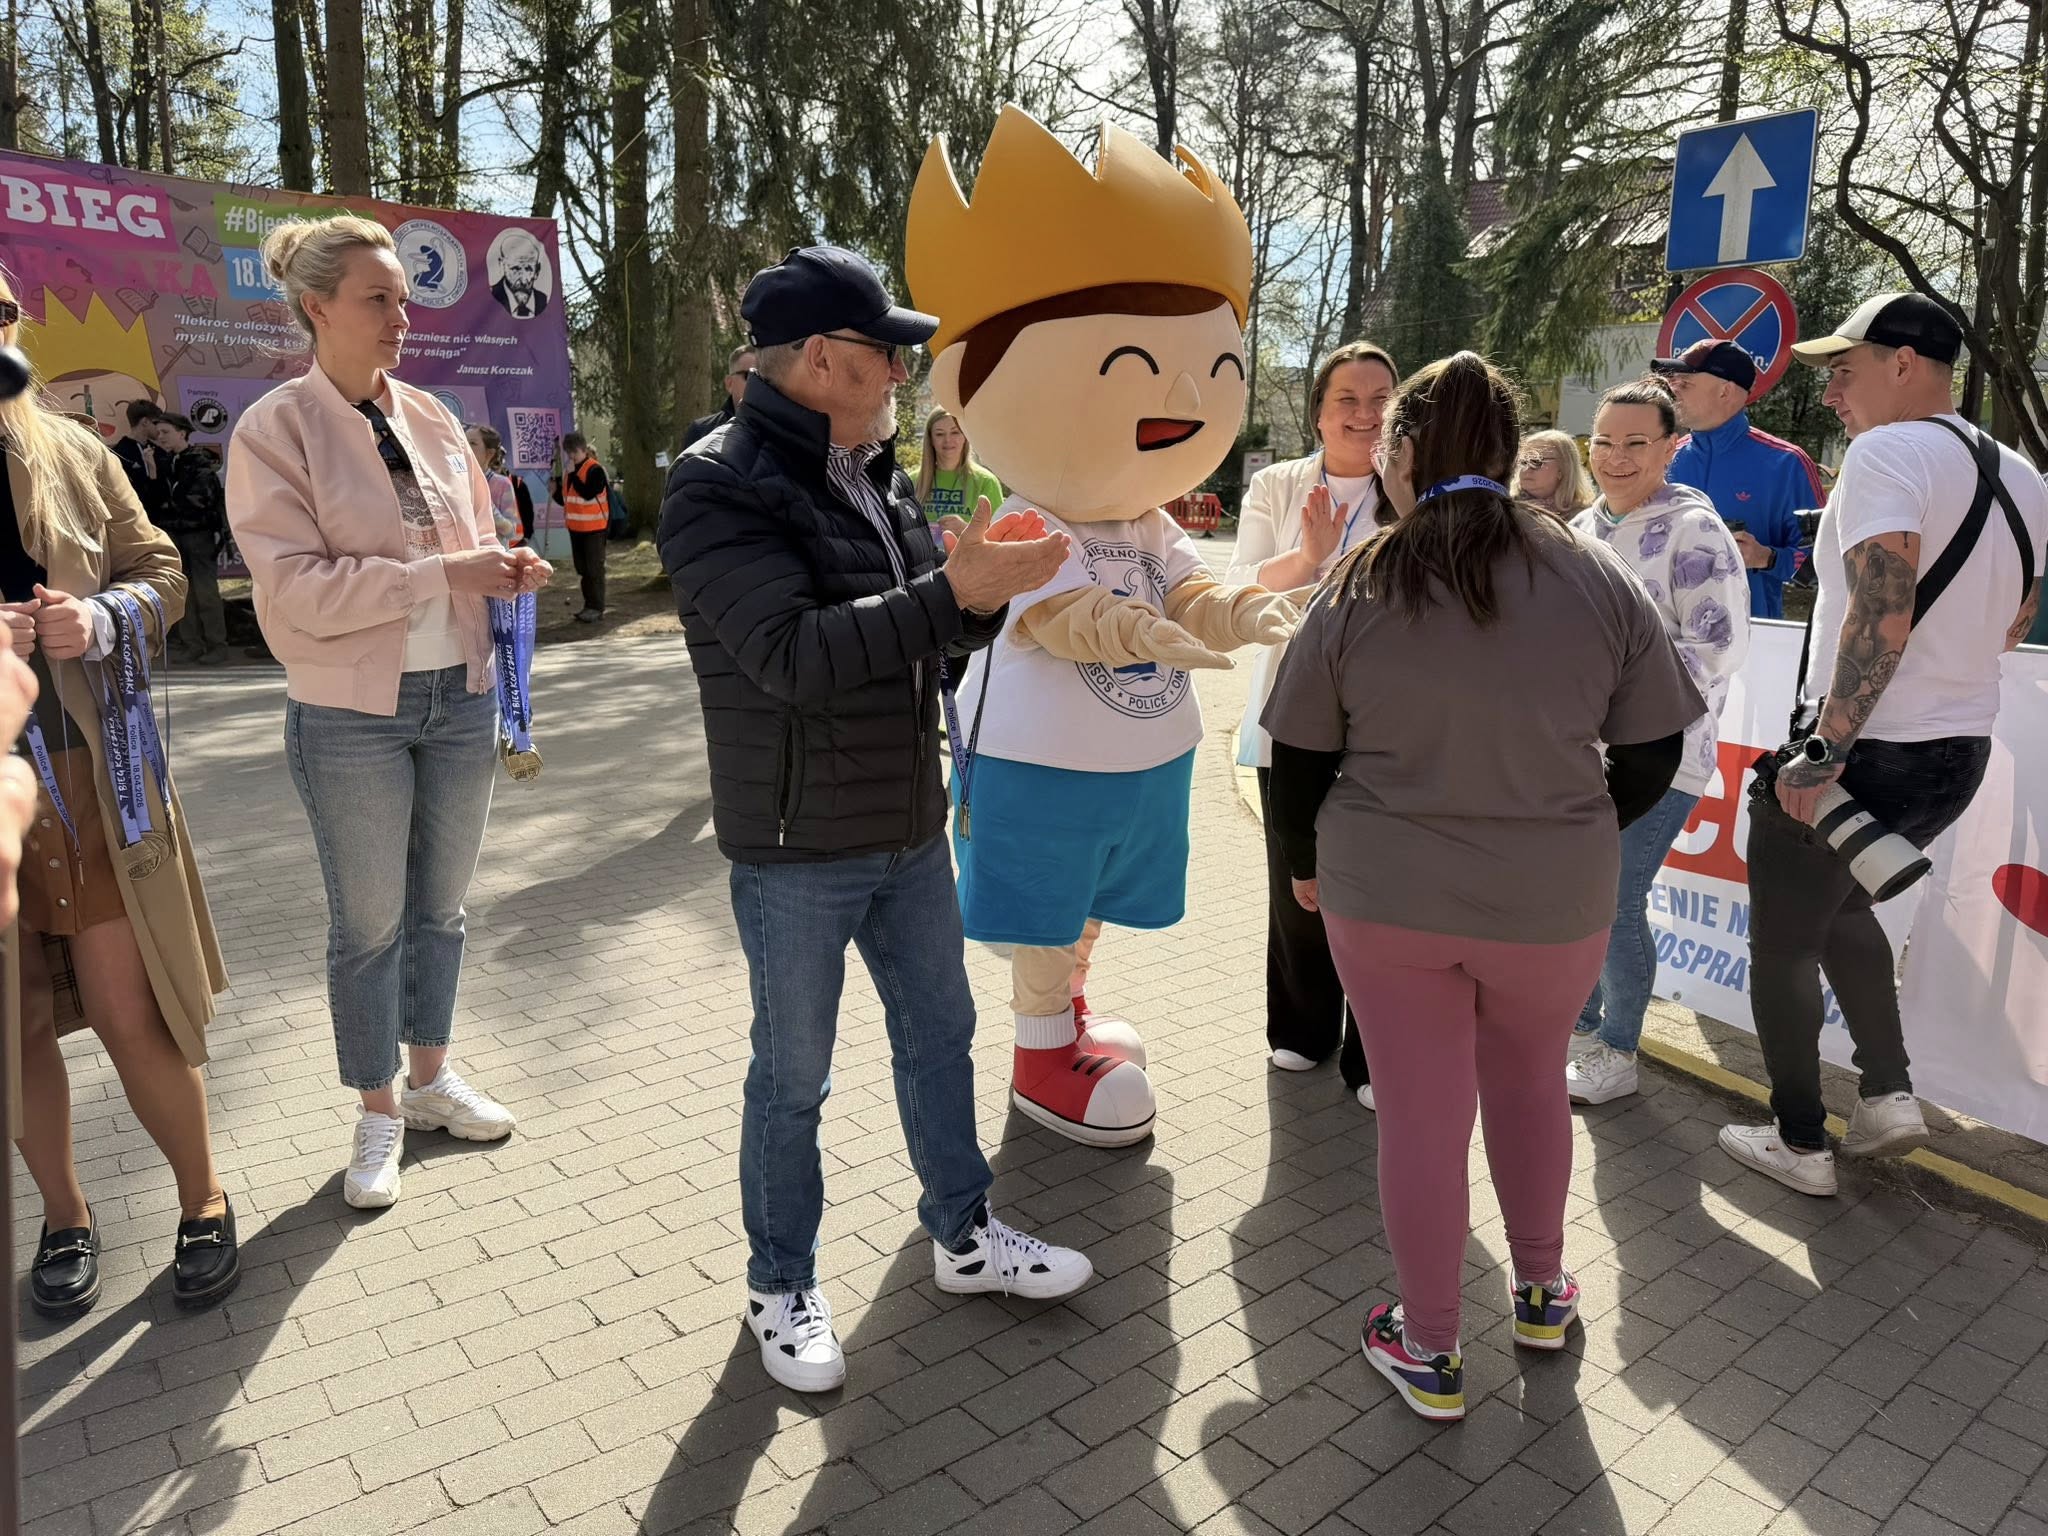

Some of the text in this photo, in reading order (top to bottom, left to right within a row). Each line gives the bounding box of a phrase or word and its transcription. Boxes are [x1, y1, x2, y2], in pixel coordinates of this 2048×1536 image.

[1, 175, 166, 239] BIEG
[404, 332, 451, 344] aczniesz
[400, 347, 422, 358] ony
[457, 365, 534, 376] Janusz Korczak
[506, 644, 520, 688] KORCZAKA
[1128, 695, 1168, 710] POLICE
[947, 707, 957, 732] Police
[107, 717, 124, 767] KORCZAKA
[129, 724, 138, 750] Police
[35, 745, 48, 772] Police
[116, 770, 128, 792] BIEG
[132, 763, 145, 809] 18.04.2026
